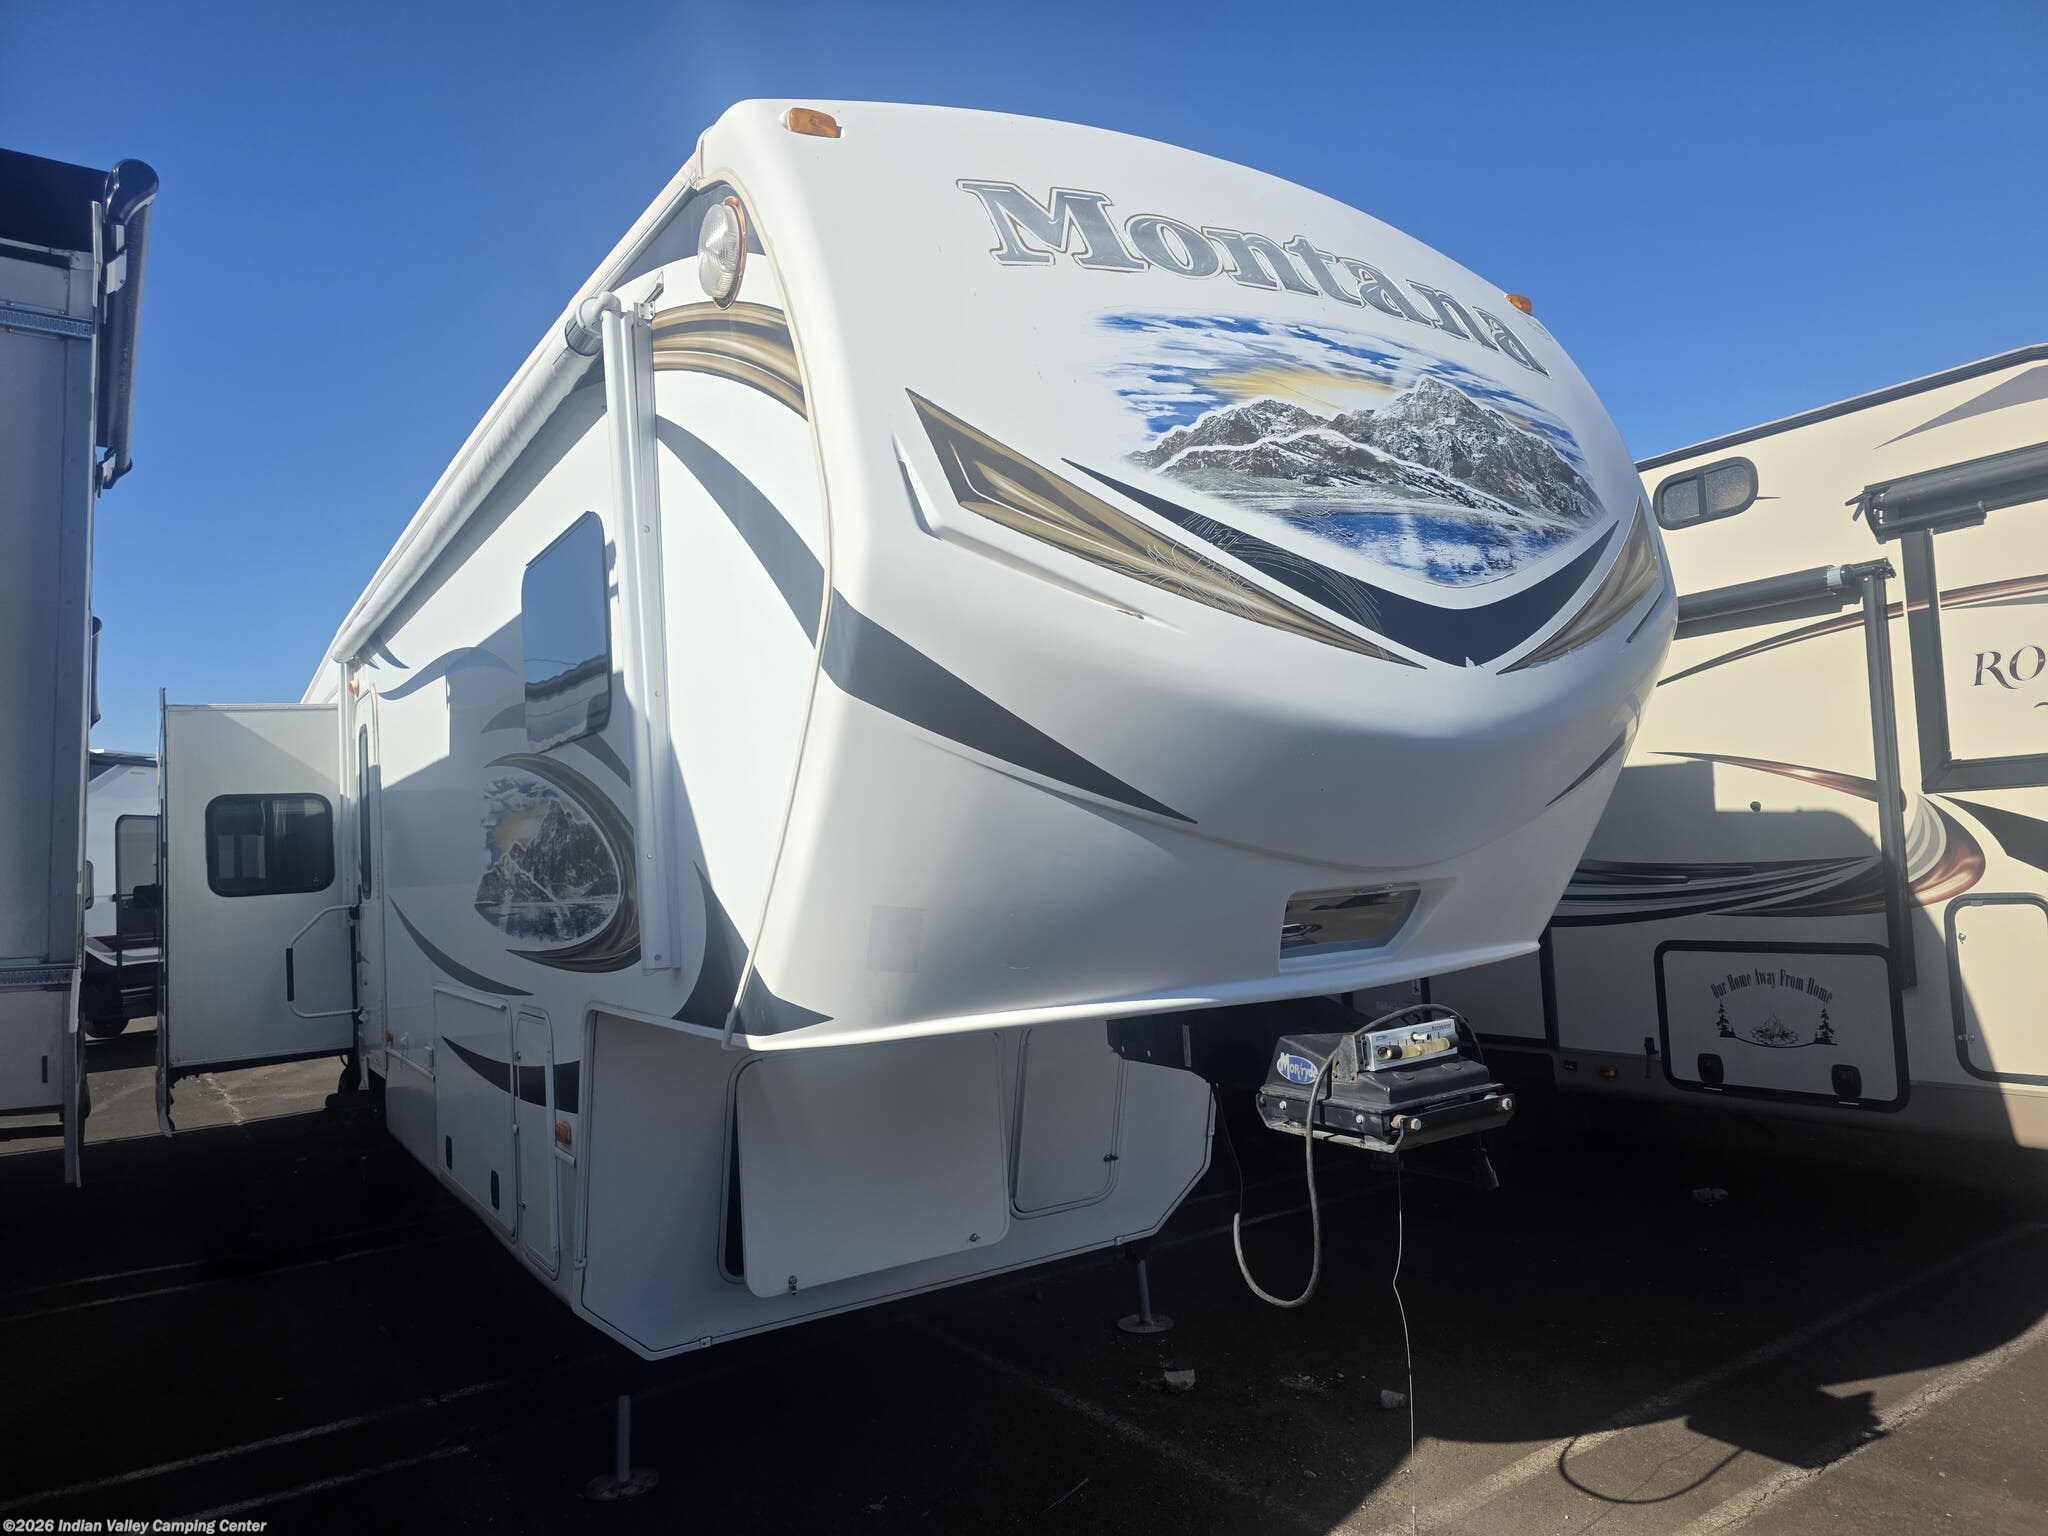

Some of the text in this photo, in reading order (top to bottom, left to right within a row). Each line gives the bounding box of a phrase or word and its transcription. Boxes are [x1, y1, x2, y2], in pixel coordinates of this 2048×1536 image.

[956, 178, 1552, 379] Montana
[1710, 968, 1833, 1004] Our Home Away From Home
